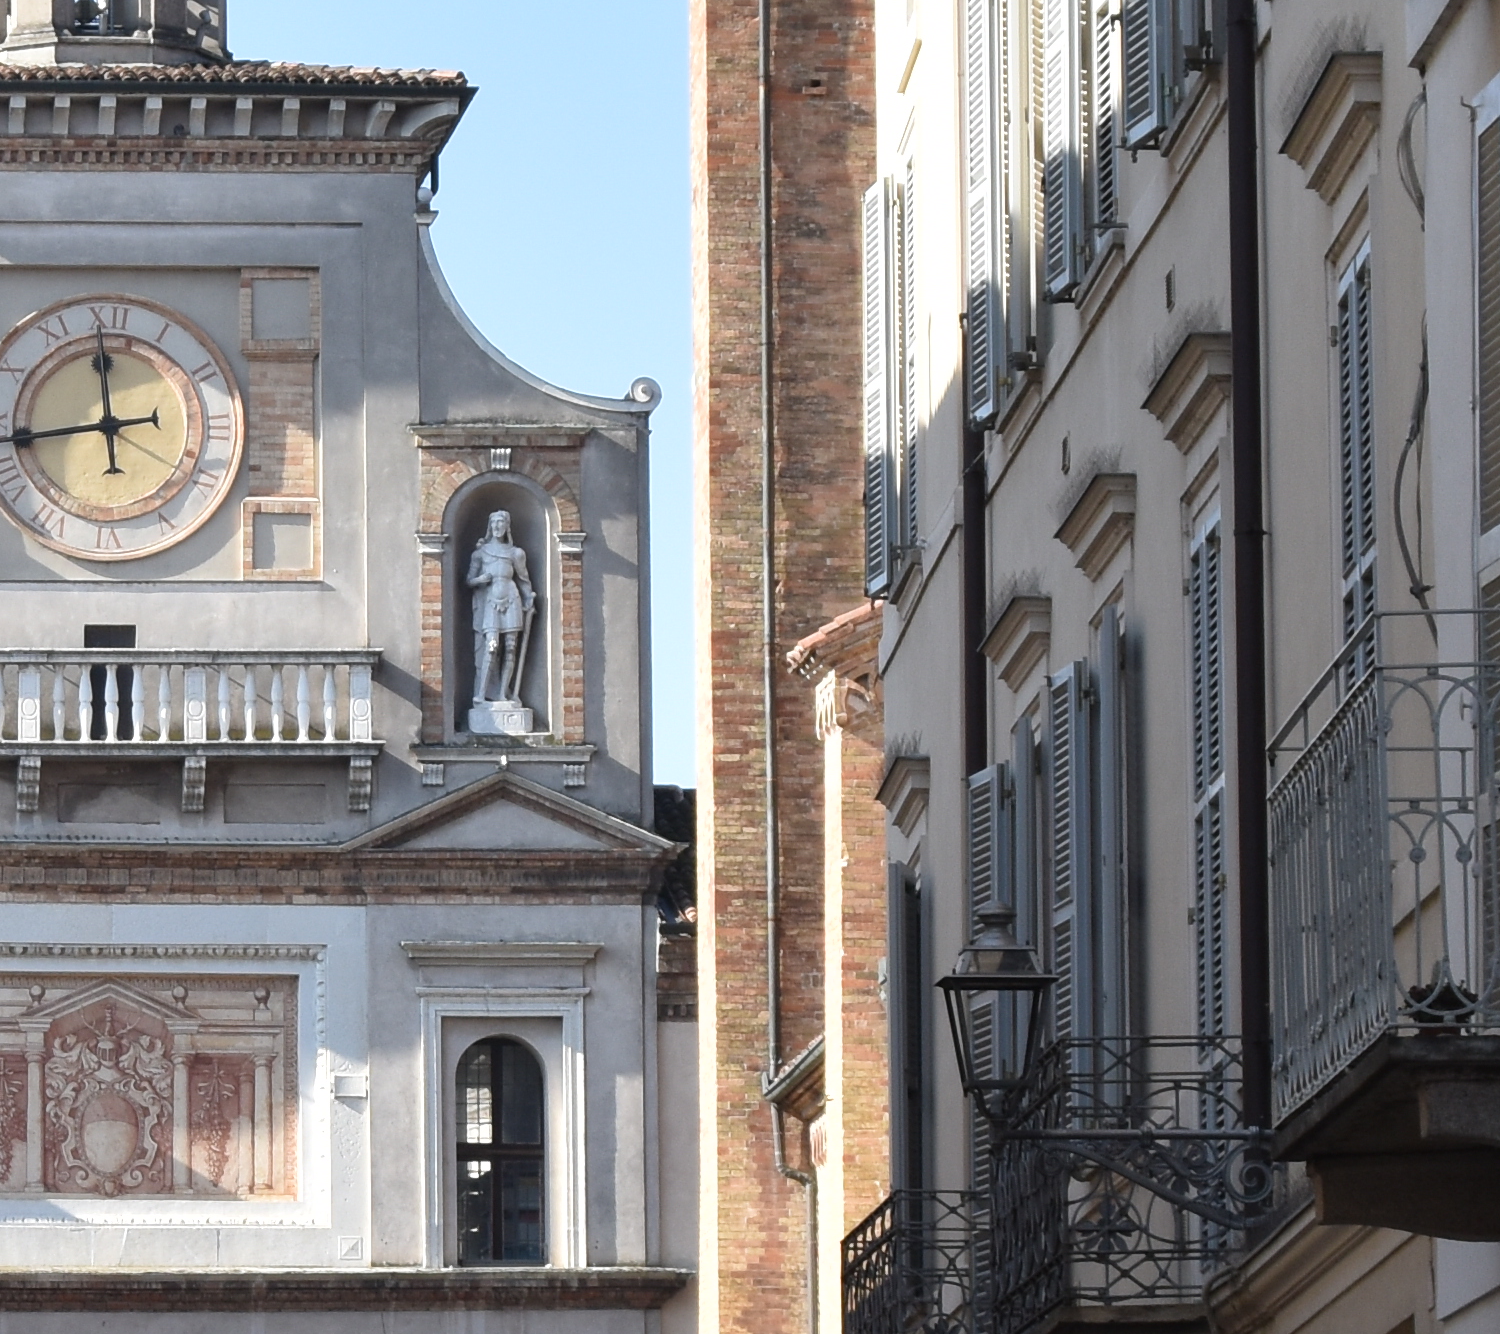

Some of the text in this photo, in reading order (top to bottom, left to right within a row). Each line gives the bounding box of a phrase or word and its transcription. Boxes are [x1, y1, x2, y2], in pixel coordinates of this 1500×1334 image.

[88, 306, 130, 330] XII
[36, 314, 71, 347] XI
[154, 320, 173, 344] I
[192, 360, 218, 383] II
[207, 413, 231, 441] III
[192, 469, 220, 500] IV
[32, 503, 66, 539] VII
[157, 512, 178, 536] V
[95, 527, 123, 549] VI
